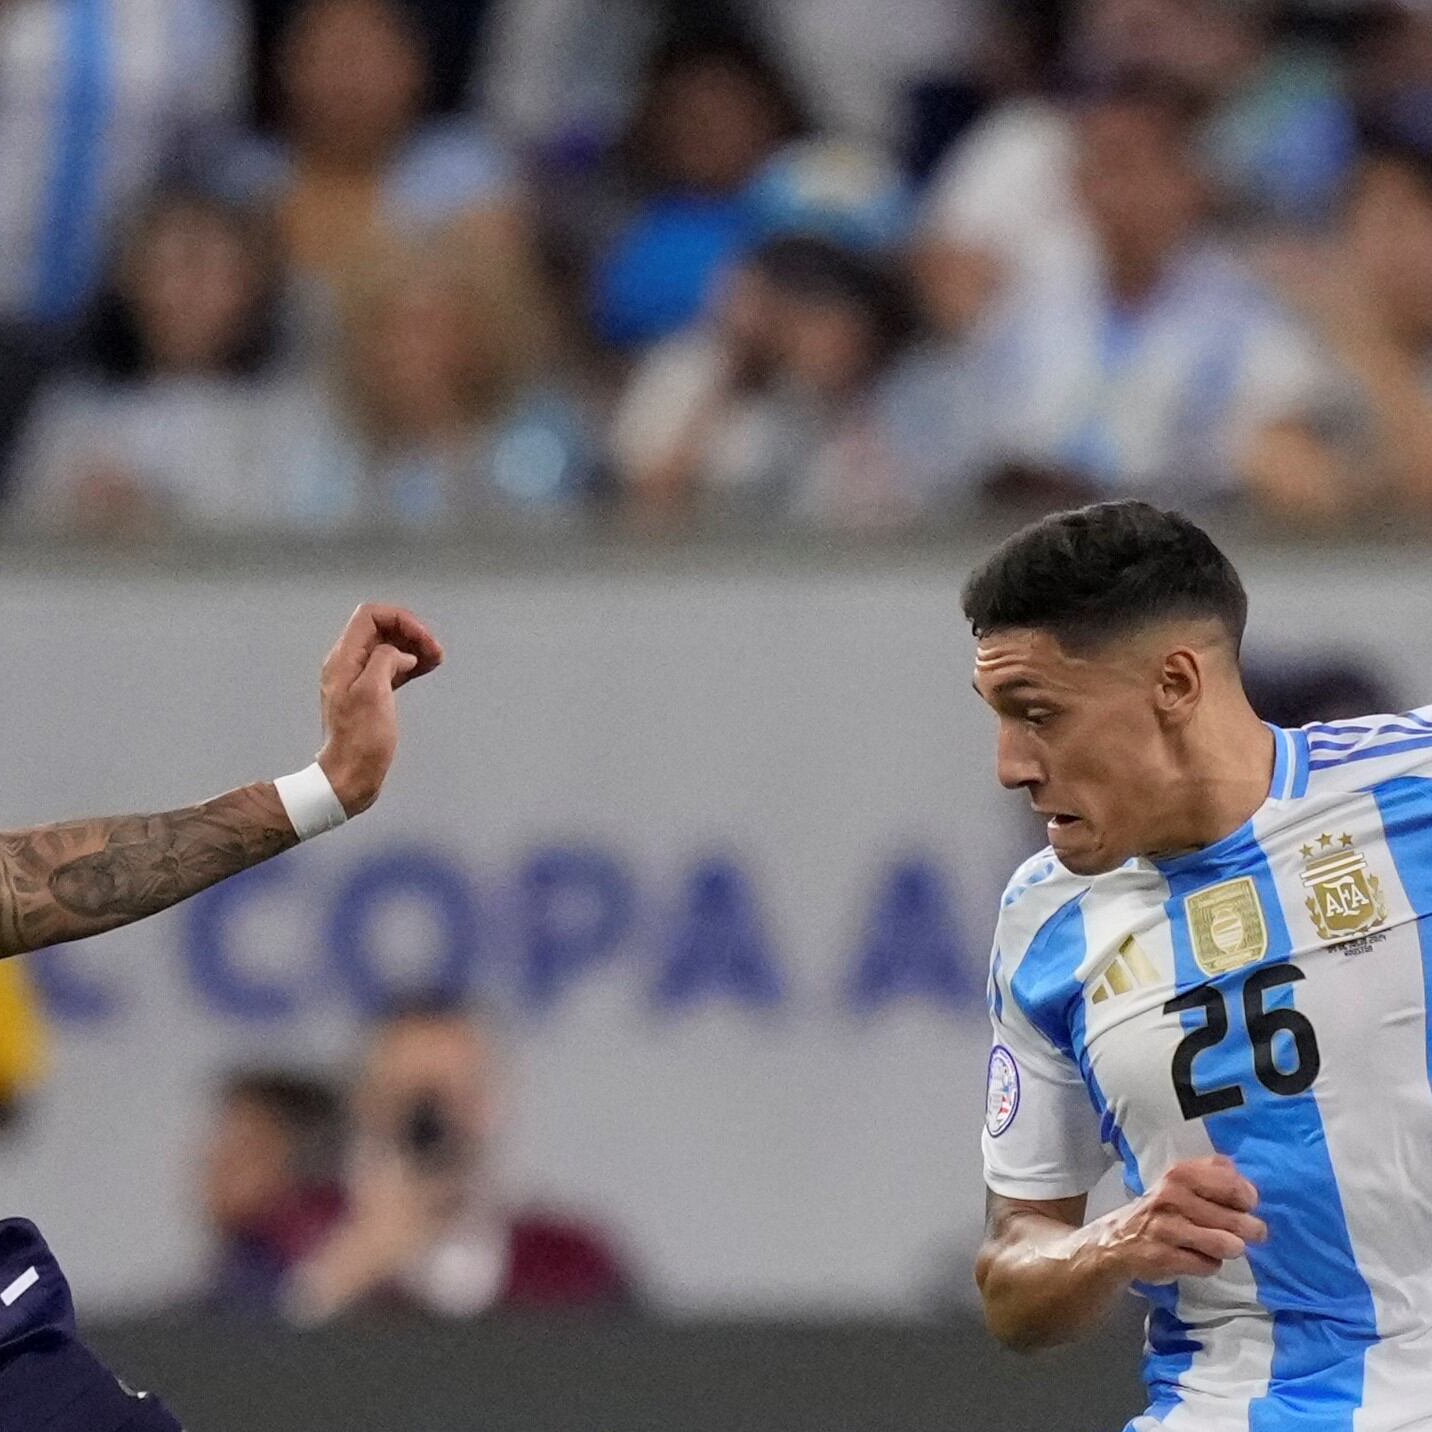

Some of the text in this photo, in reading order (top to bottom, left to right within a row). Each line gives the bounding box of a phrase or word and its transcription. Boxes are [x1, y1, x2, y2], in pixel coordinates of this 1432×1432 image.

[183, 842, 784, 1022] COPA
[1323, 875, 1370, 917] AFA
[1162, 963, 1321, 1121] 26
